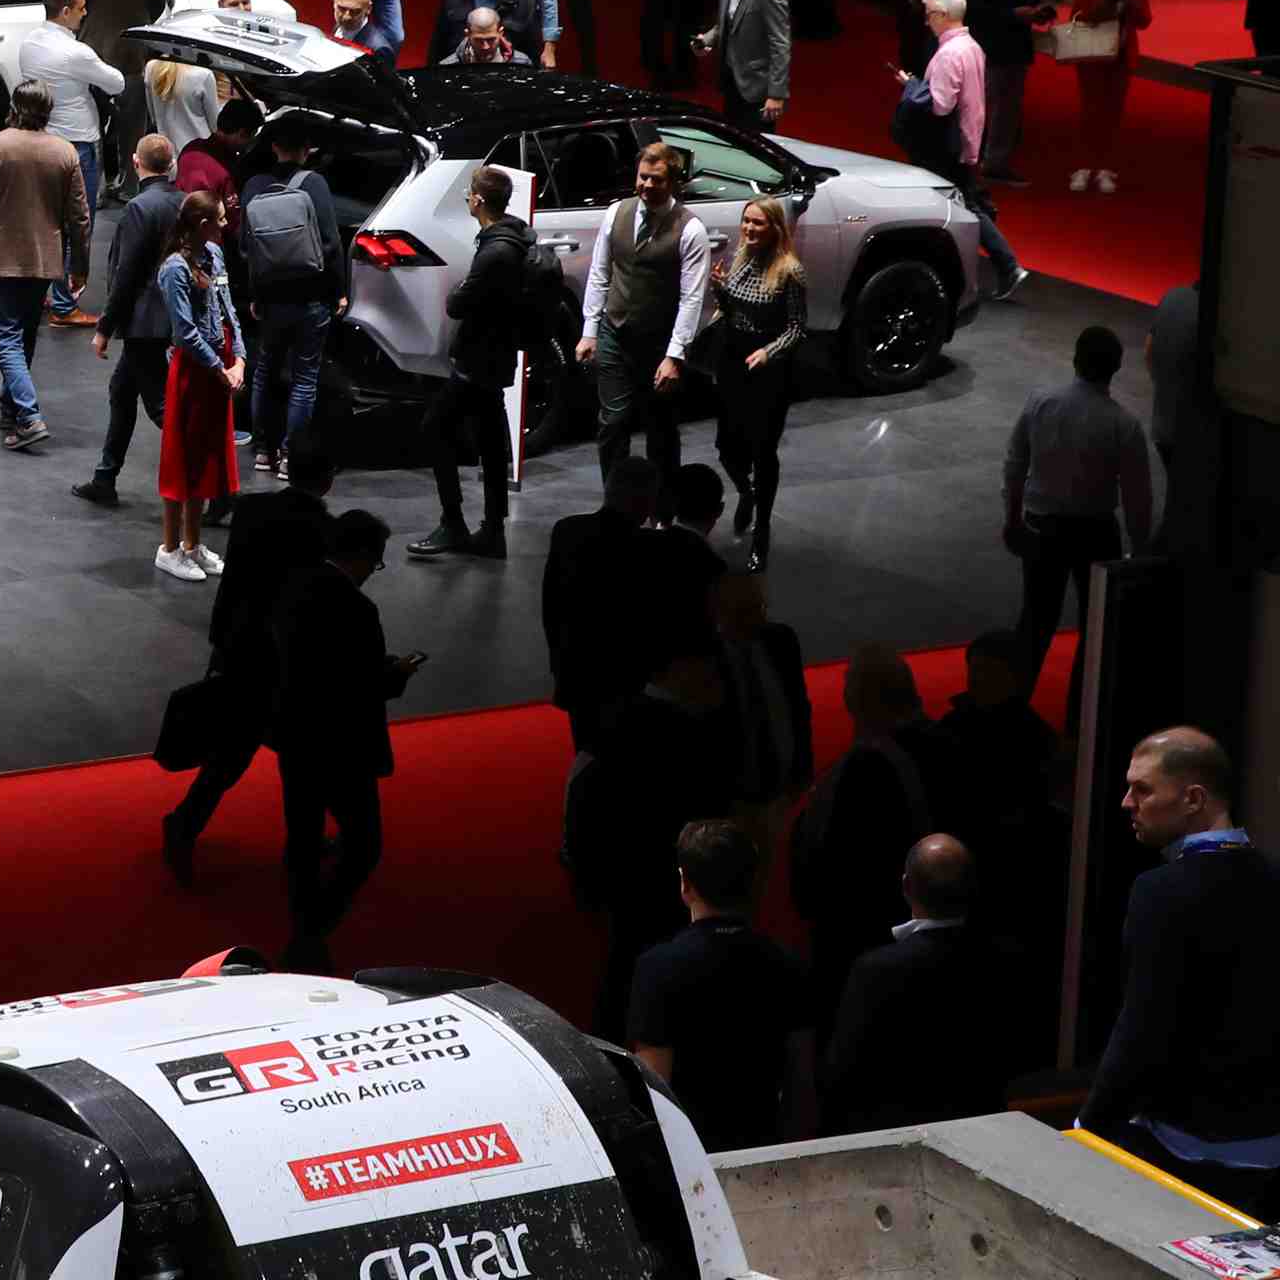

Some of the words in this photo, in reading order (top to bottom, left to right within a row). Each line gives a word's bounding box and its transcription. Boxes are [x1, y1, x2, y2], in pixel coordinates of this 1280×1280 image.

[173, 1053, 312, 1103] GR
[301, 1013, 464, 1046] TOYOTA
[314, 1027, 460, 1061] GAZOO
[328, 1042, 472, 1077] Racing
[279, 1087, 352, 1115] South
[357, 1075, 426, 1103] Africa
[303, 1131, 508, 1192] #TEAMHILUX
